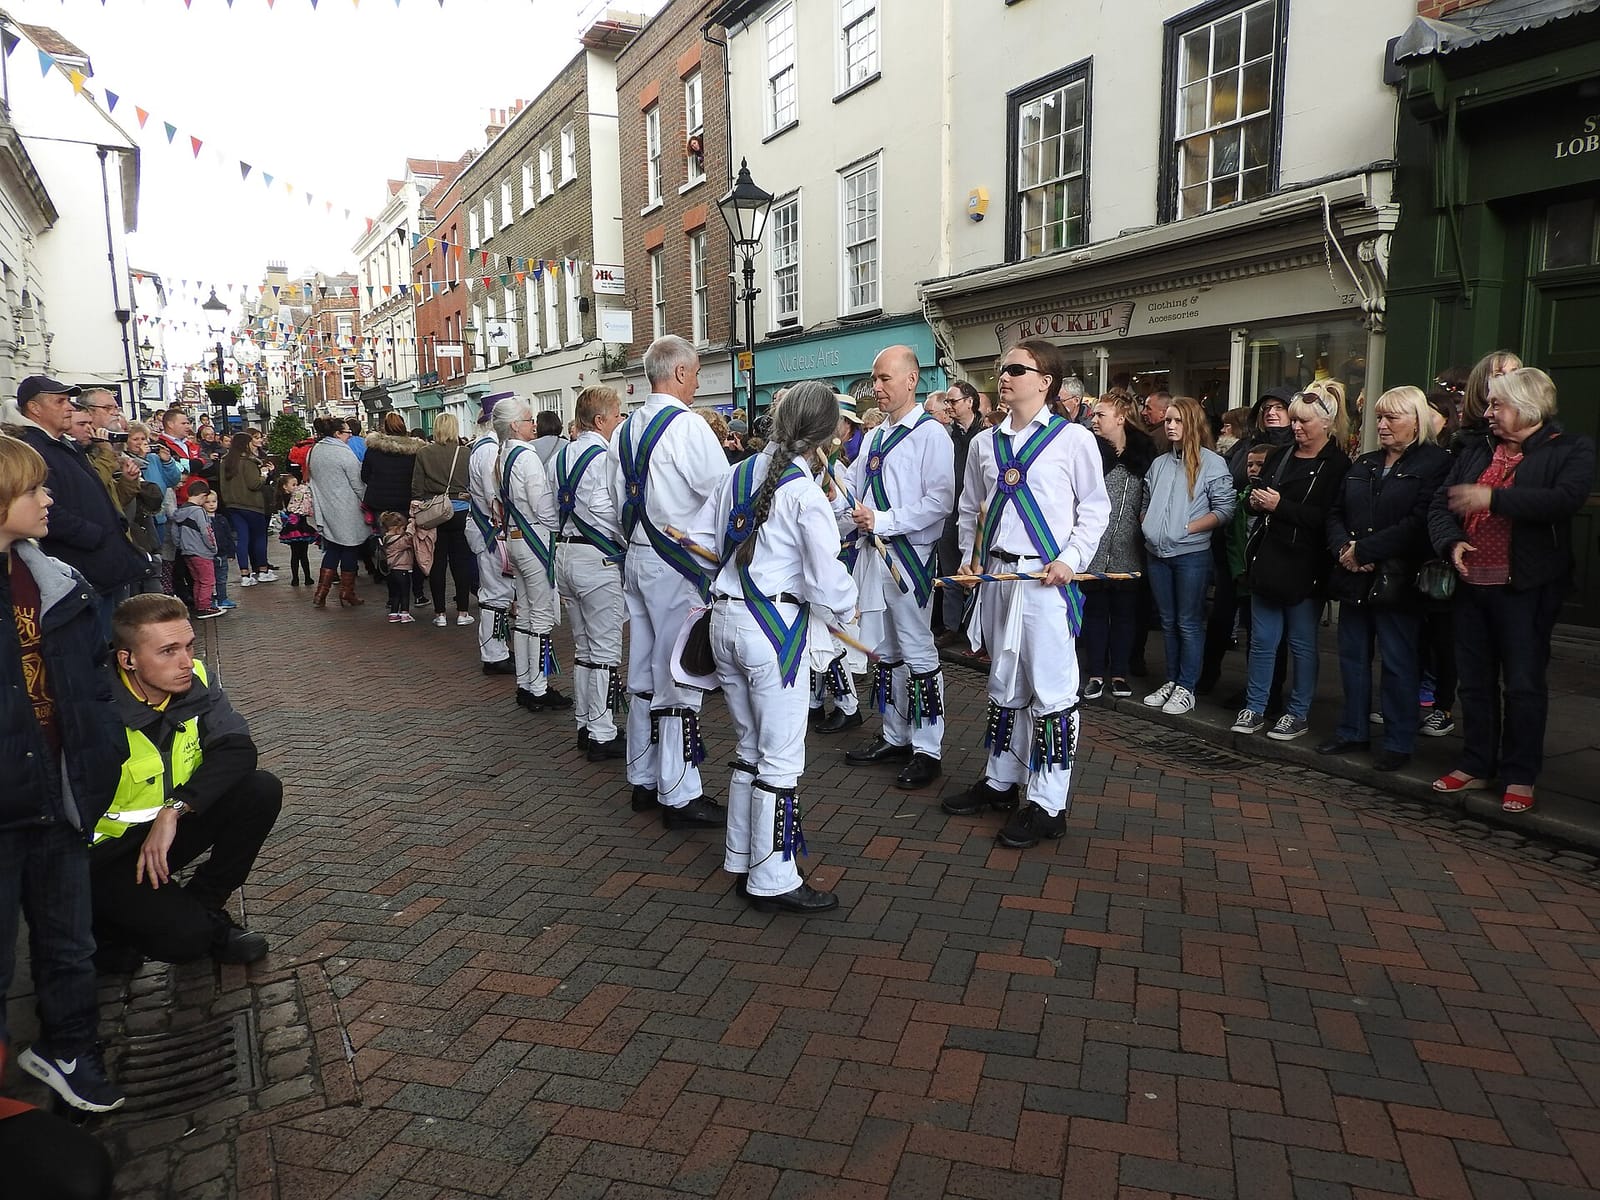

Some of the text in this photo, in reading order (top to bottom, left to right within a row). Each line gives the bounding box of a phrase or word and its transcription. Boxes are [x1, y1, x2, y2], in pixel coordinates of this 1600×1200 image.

[1584, 115, 1600, 133] S
[1147, 295, 1199, 312] Clothing &
[1018, 308, 1112, 339] ROCKET
[1147, 310, 1199, 324] Accessories
[777, 351, 815, 373] Nucleus
[816, 345, 840, 369] Arts
